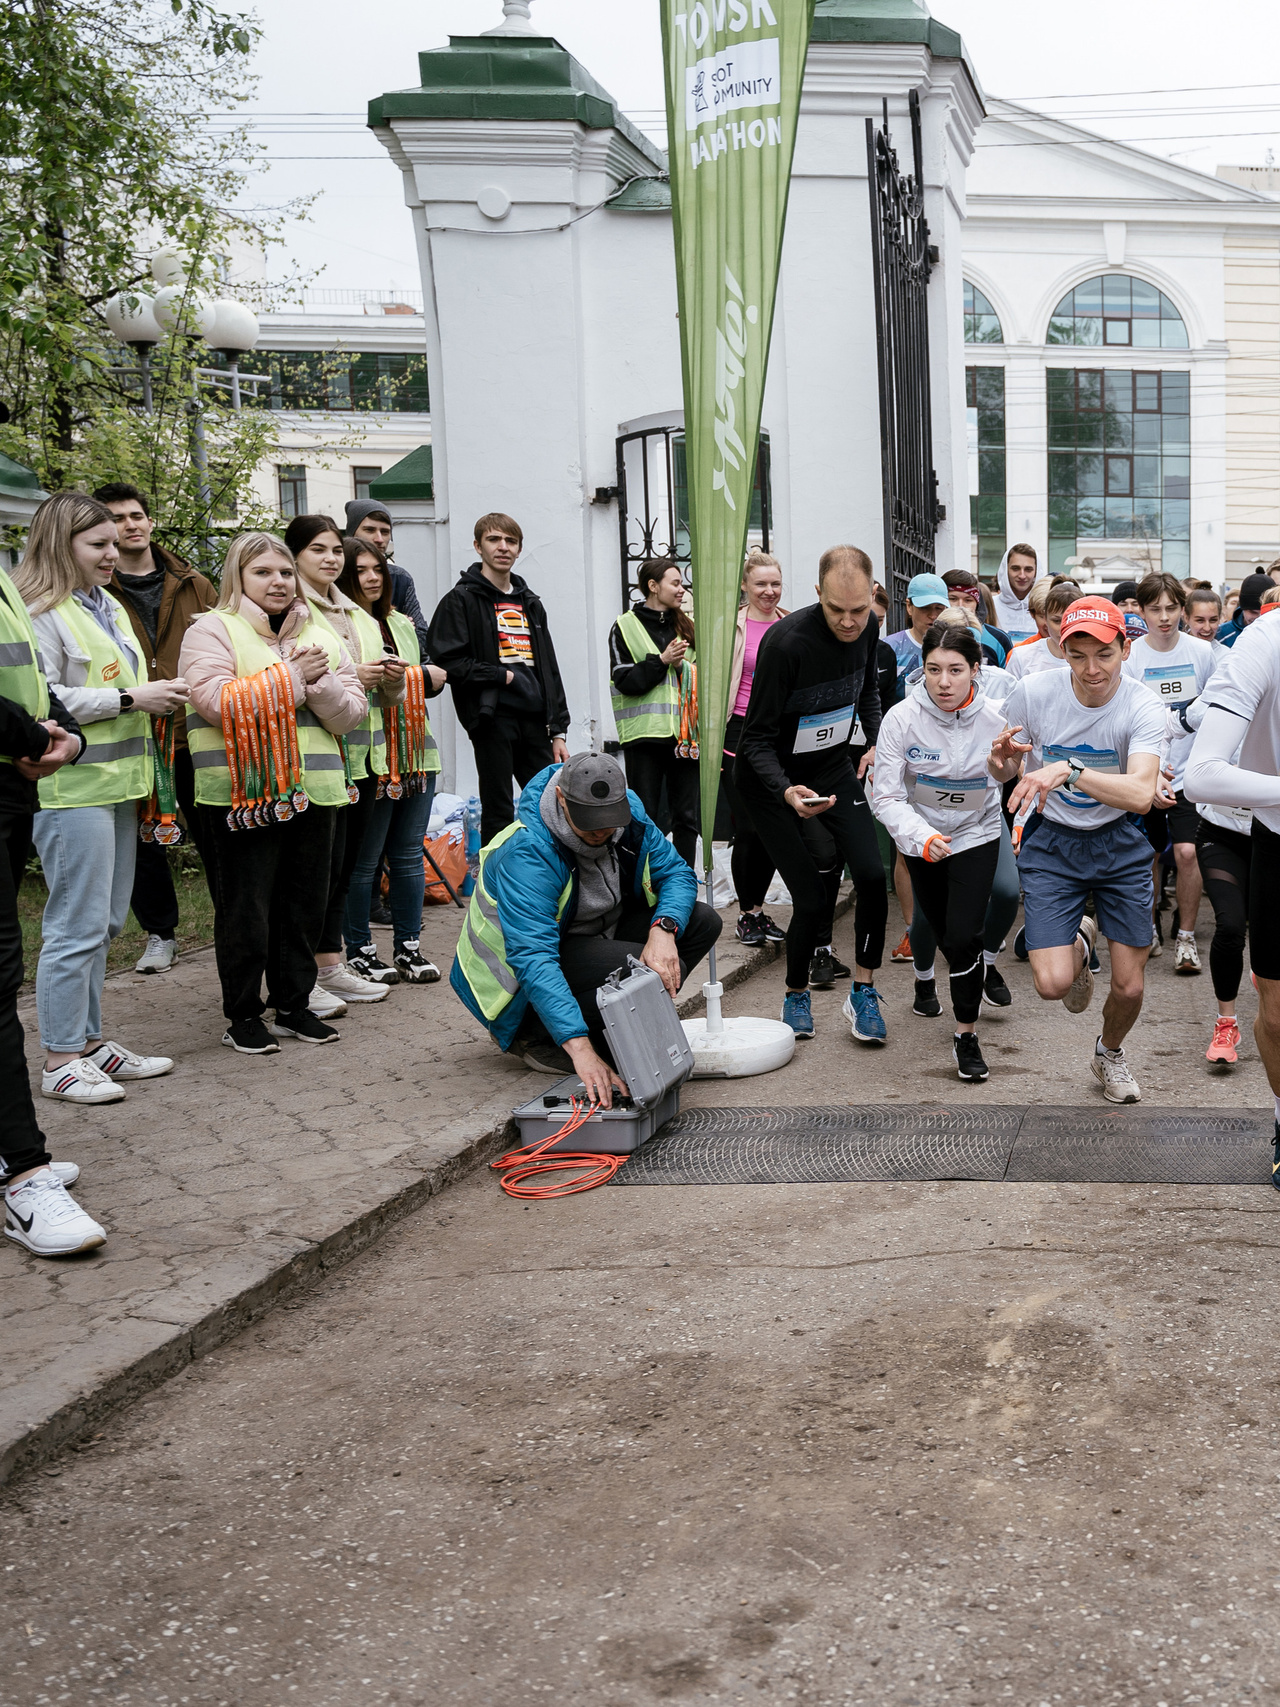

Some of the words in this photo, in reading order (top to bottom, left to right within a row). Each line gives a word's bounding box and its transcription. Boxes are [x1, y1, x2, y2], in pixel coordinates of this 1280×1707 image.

[1066, 609, 1109, 625] RUSSIA
[1160, 681, 1182, 694] 88
[236, 693, 244, 723] MARATHON
[265, 686, 274, 715] MARATHON
[815, 726, 834, 742] 91
[935, 790, 965, 803] 76
